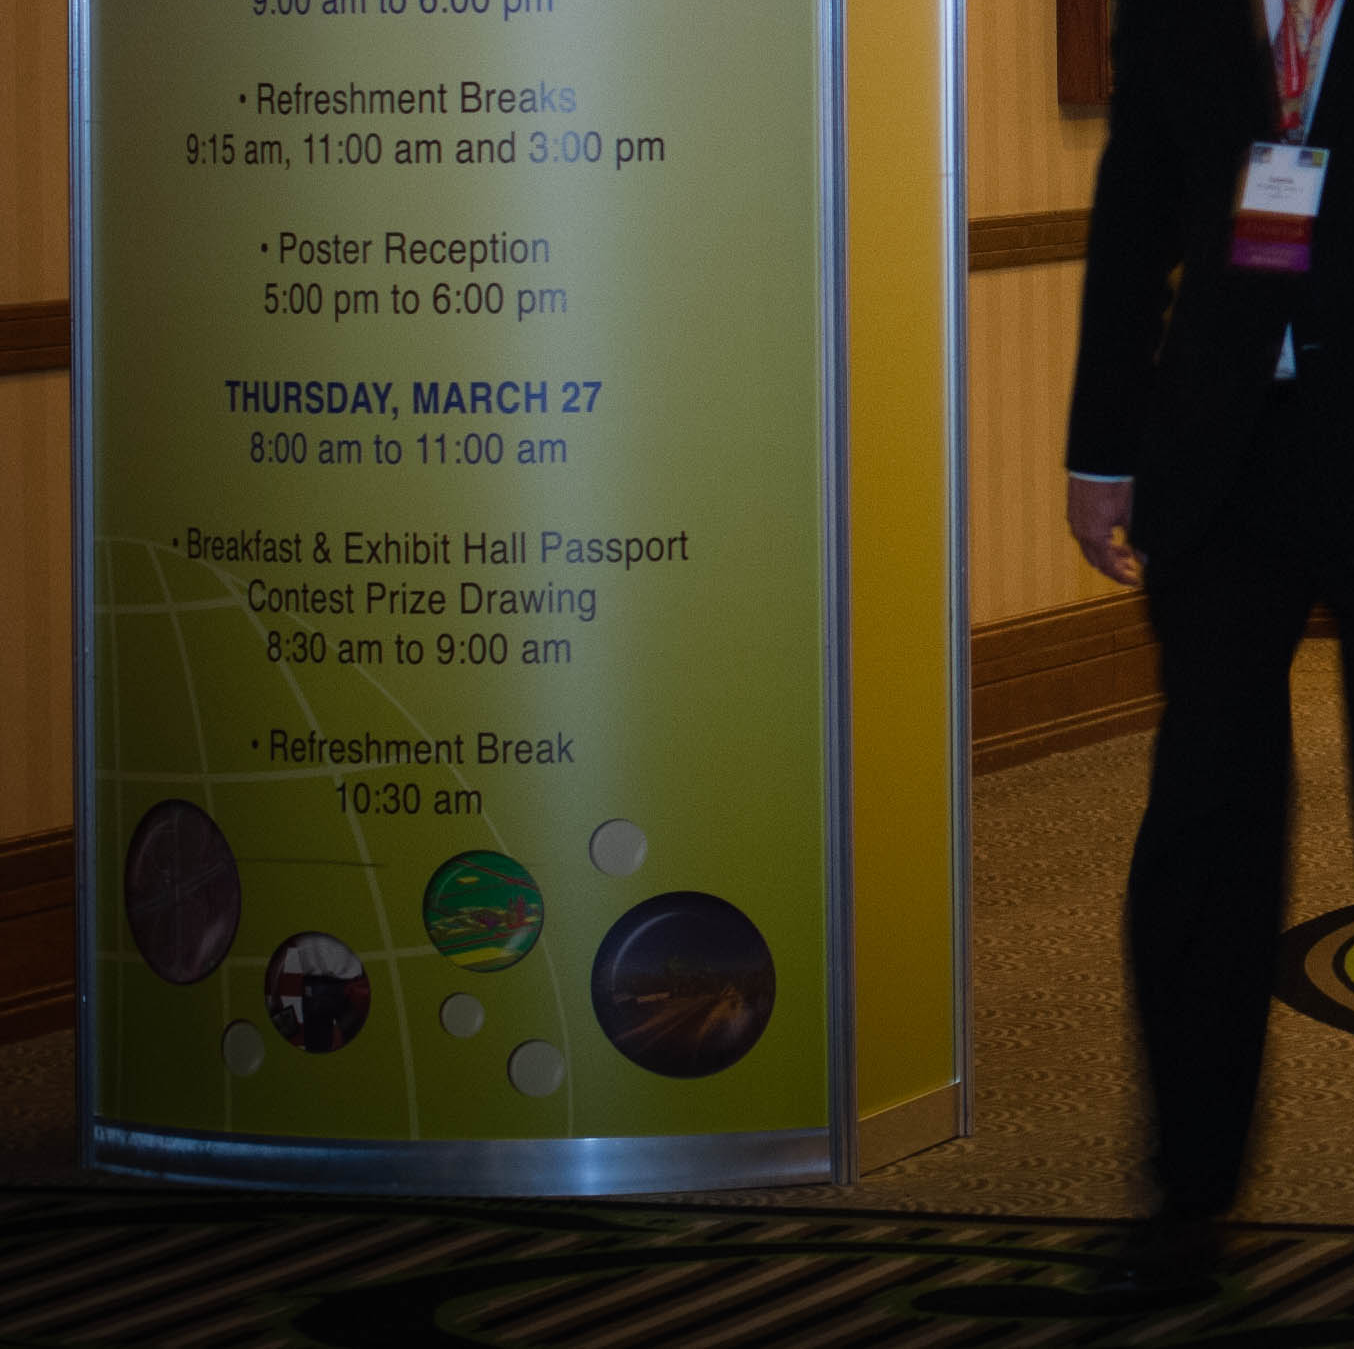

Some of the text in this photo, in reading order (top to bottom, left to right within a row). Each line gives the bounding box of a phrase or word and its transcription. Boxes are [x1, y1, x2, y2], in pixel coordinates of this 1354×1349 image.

[257, 80, 577, 117] Refreshment Breaks
[185, 131, 665, 171] 9:15 am, 11:00 am and 3:00 pm
[279, 230, 550, 272] Poster Reception
[263, 282, 567, 321] 5:00 pm to 6:00 pm
[225, 381, 602, 420] THURSDAY, MARCH 27
[250, 432, 568, 465] 8:00 am to 11:00 am
[187, 529, 689, 570] Breakfast & Exhibit Hall Passport
[247, 578, 598, 622] Contest Prize Drawing
[267, 632, 572, 666] 8:30 am to 9:00 am
[269, 730, 575, 765] Refreshment Break
[336, 782, 482, 815] 10:30 am
